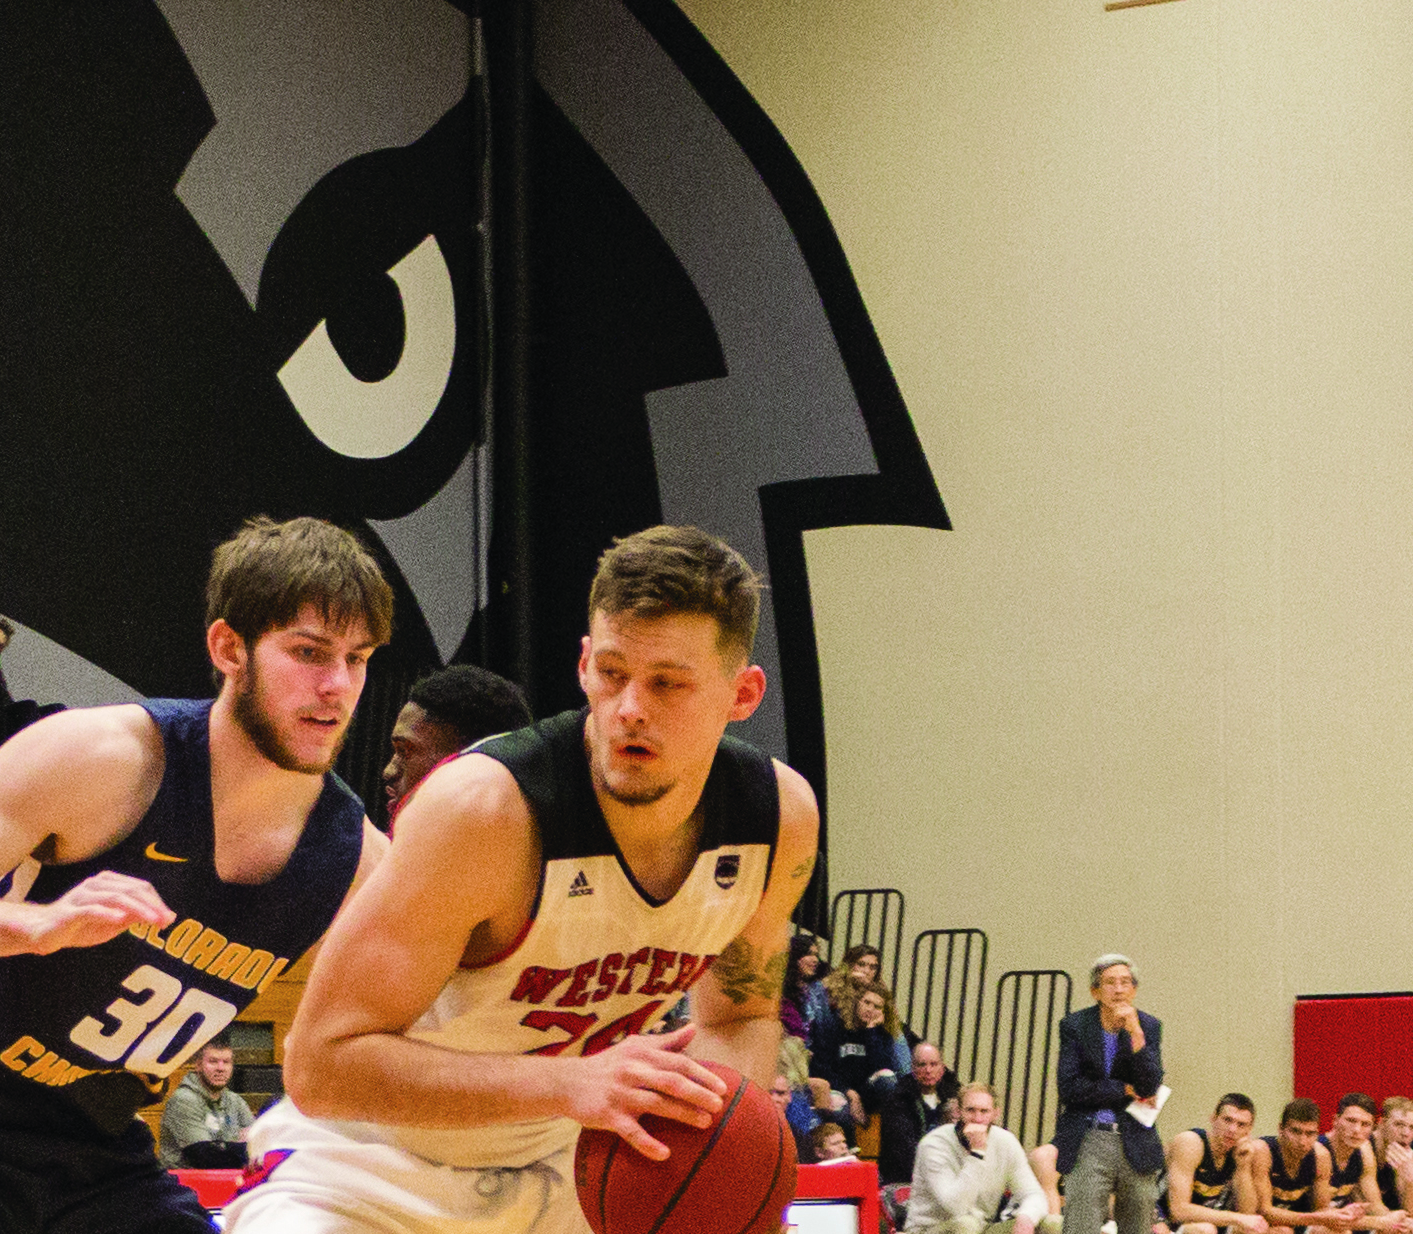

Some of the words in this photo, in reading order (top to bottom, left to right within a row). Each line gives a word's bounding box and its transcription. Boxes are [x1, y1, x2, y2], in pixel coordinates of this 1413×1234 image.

[129, 918, 290, 994] LORAD
[510, 946, 720, 1008] WESTER
[69, 963, 238, 1079] 30
